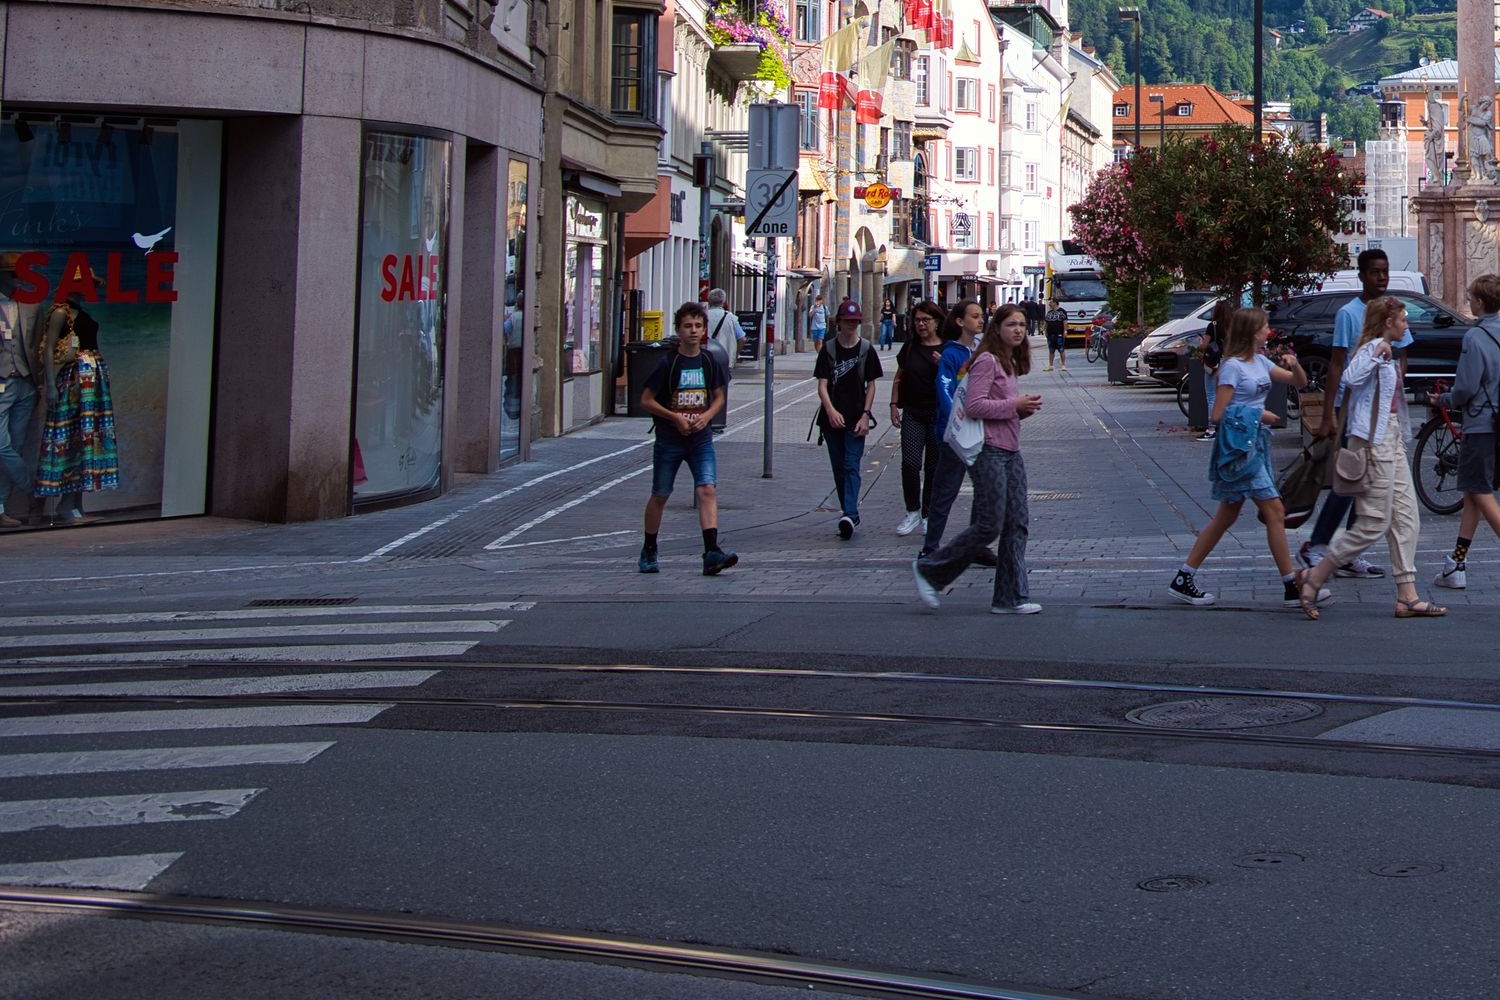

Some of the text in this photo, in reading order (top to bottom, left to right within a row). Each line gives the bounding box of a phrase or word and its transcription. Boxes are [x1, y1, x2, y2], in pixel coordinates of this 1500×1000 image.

[757, 182, 786, 208] 30
[754, 221, 788, 234] Zone
[11, 250, 180, 305] SALE
[380, 253, 440, 303] SALE
[681, 371, 705, 385] CHILL
[678, 391, 705, 406] BEACH
